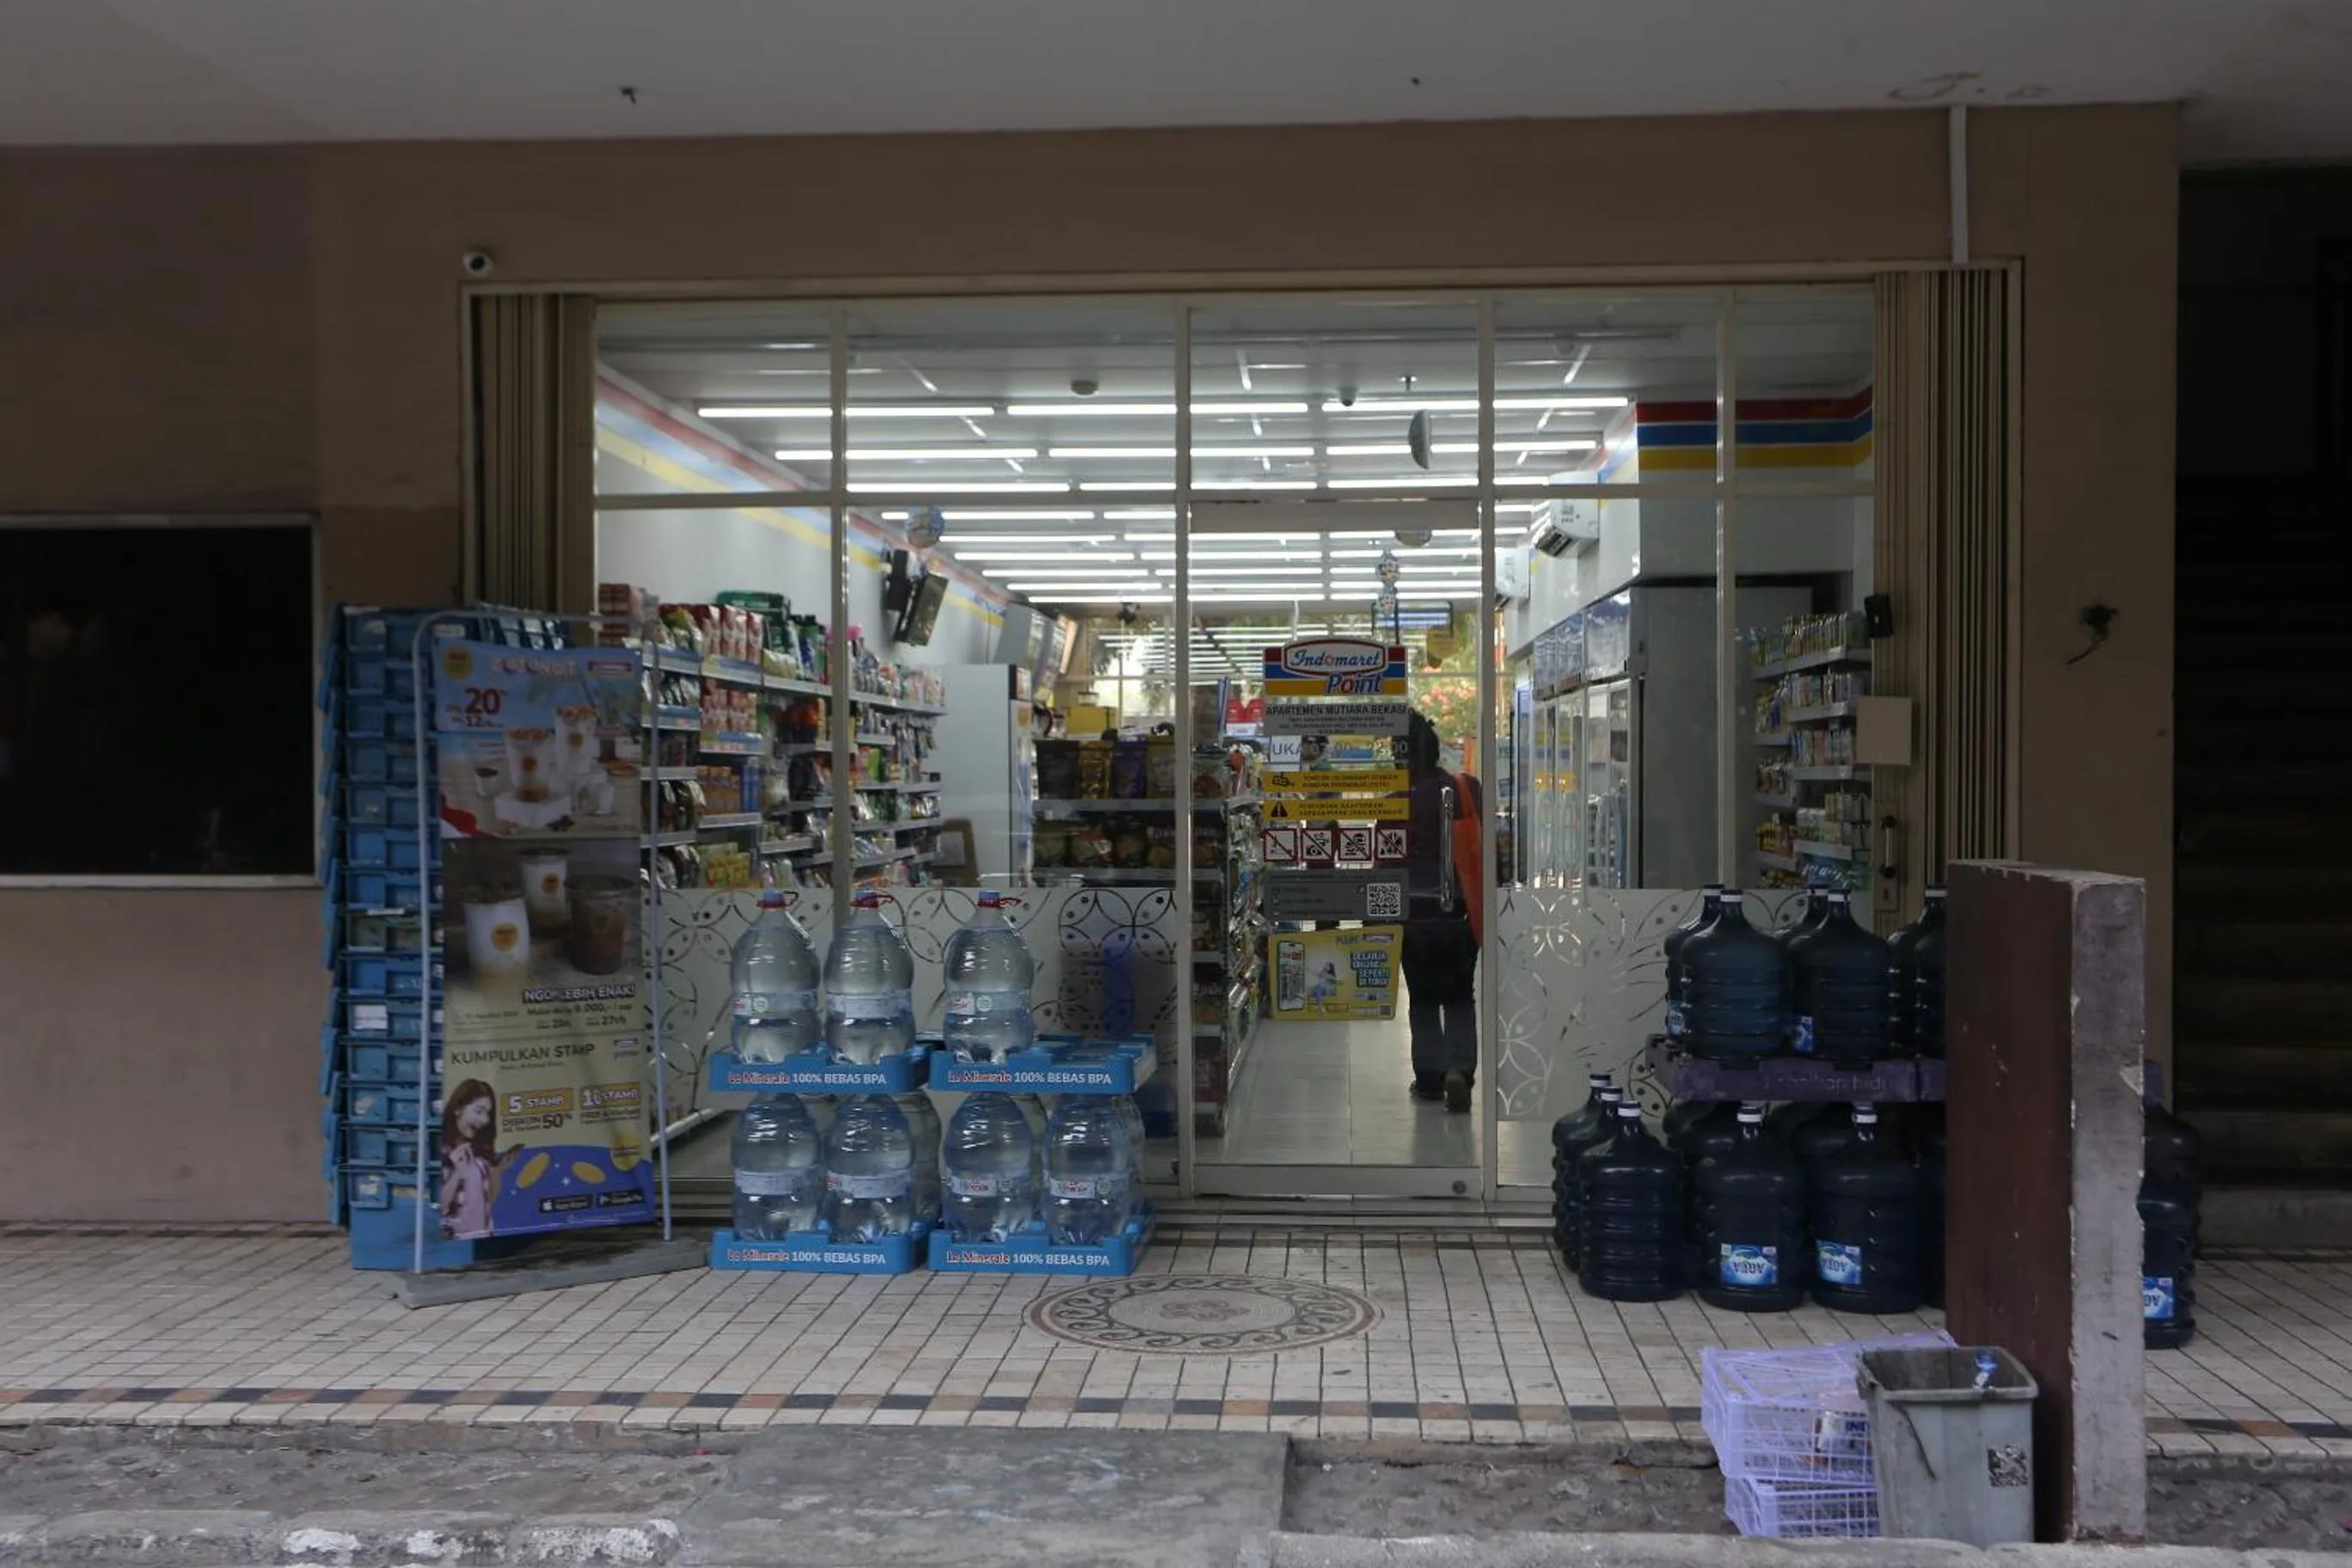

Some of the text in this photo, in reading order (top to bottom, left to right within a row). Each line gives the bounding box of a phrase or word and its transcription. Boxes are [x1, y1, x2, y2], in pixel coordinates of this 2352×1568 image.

[1289, 649, 1381, 667] Indomaret
[1326, 673, 1383, 694] Point
[1265, 704, 1407, 716] APARTEMEN MUTIARA BEKASI
[451, 1047, 551, 1065] KUMPULKAN
[554, 1043, 596, 1059] STAMP
[792, 1073, 823, 1083] 100%
[824, 1073, 861, 1084] BEBAS
[863, 1074, 887, 1084] BPA
[1014, 1072, 1045, 1083] 100%
[1047, 1072, 1085, 1083] BEBAS
[1087, 1073, 1112, 1085] BPA
[508, 1095, 523, 1113] 5
[792, 1252, 822, 1262] 100%
[824, 1252, 861, 1264] BEBAS
[862, 1253, 886, 1264] BPA
[1013, 1253, 1044, 1264] 100%
[1045, 1253, 1084, 1265] BEBAS
[1086, 1254, 1110, 1265] BPA
